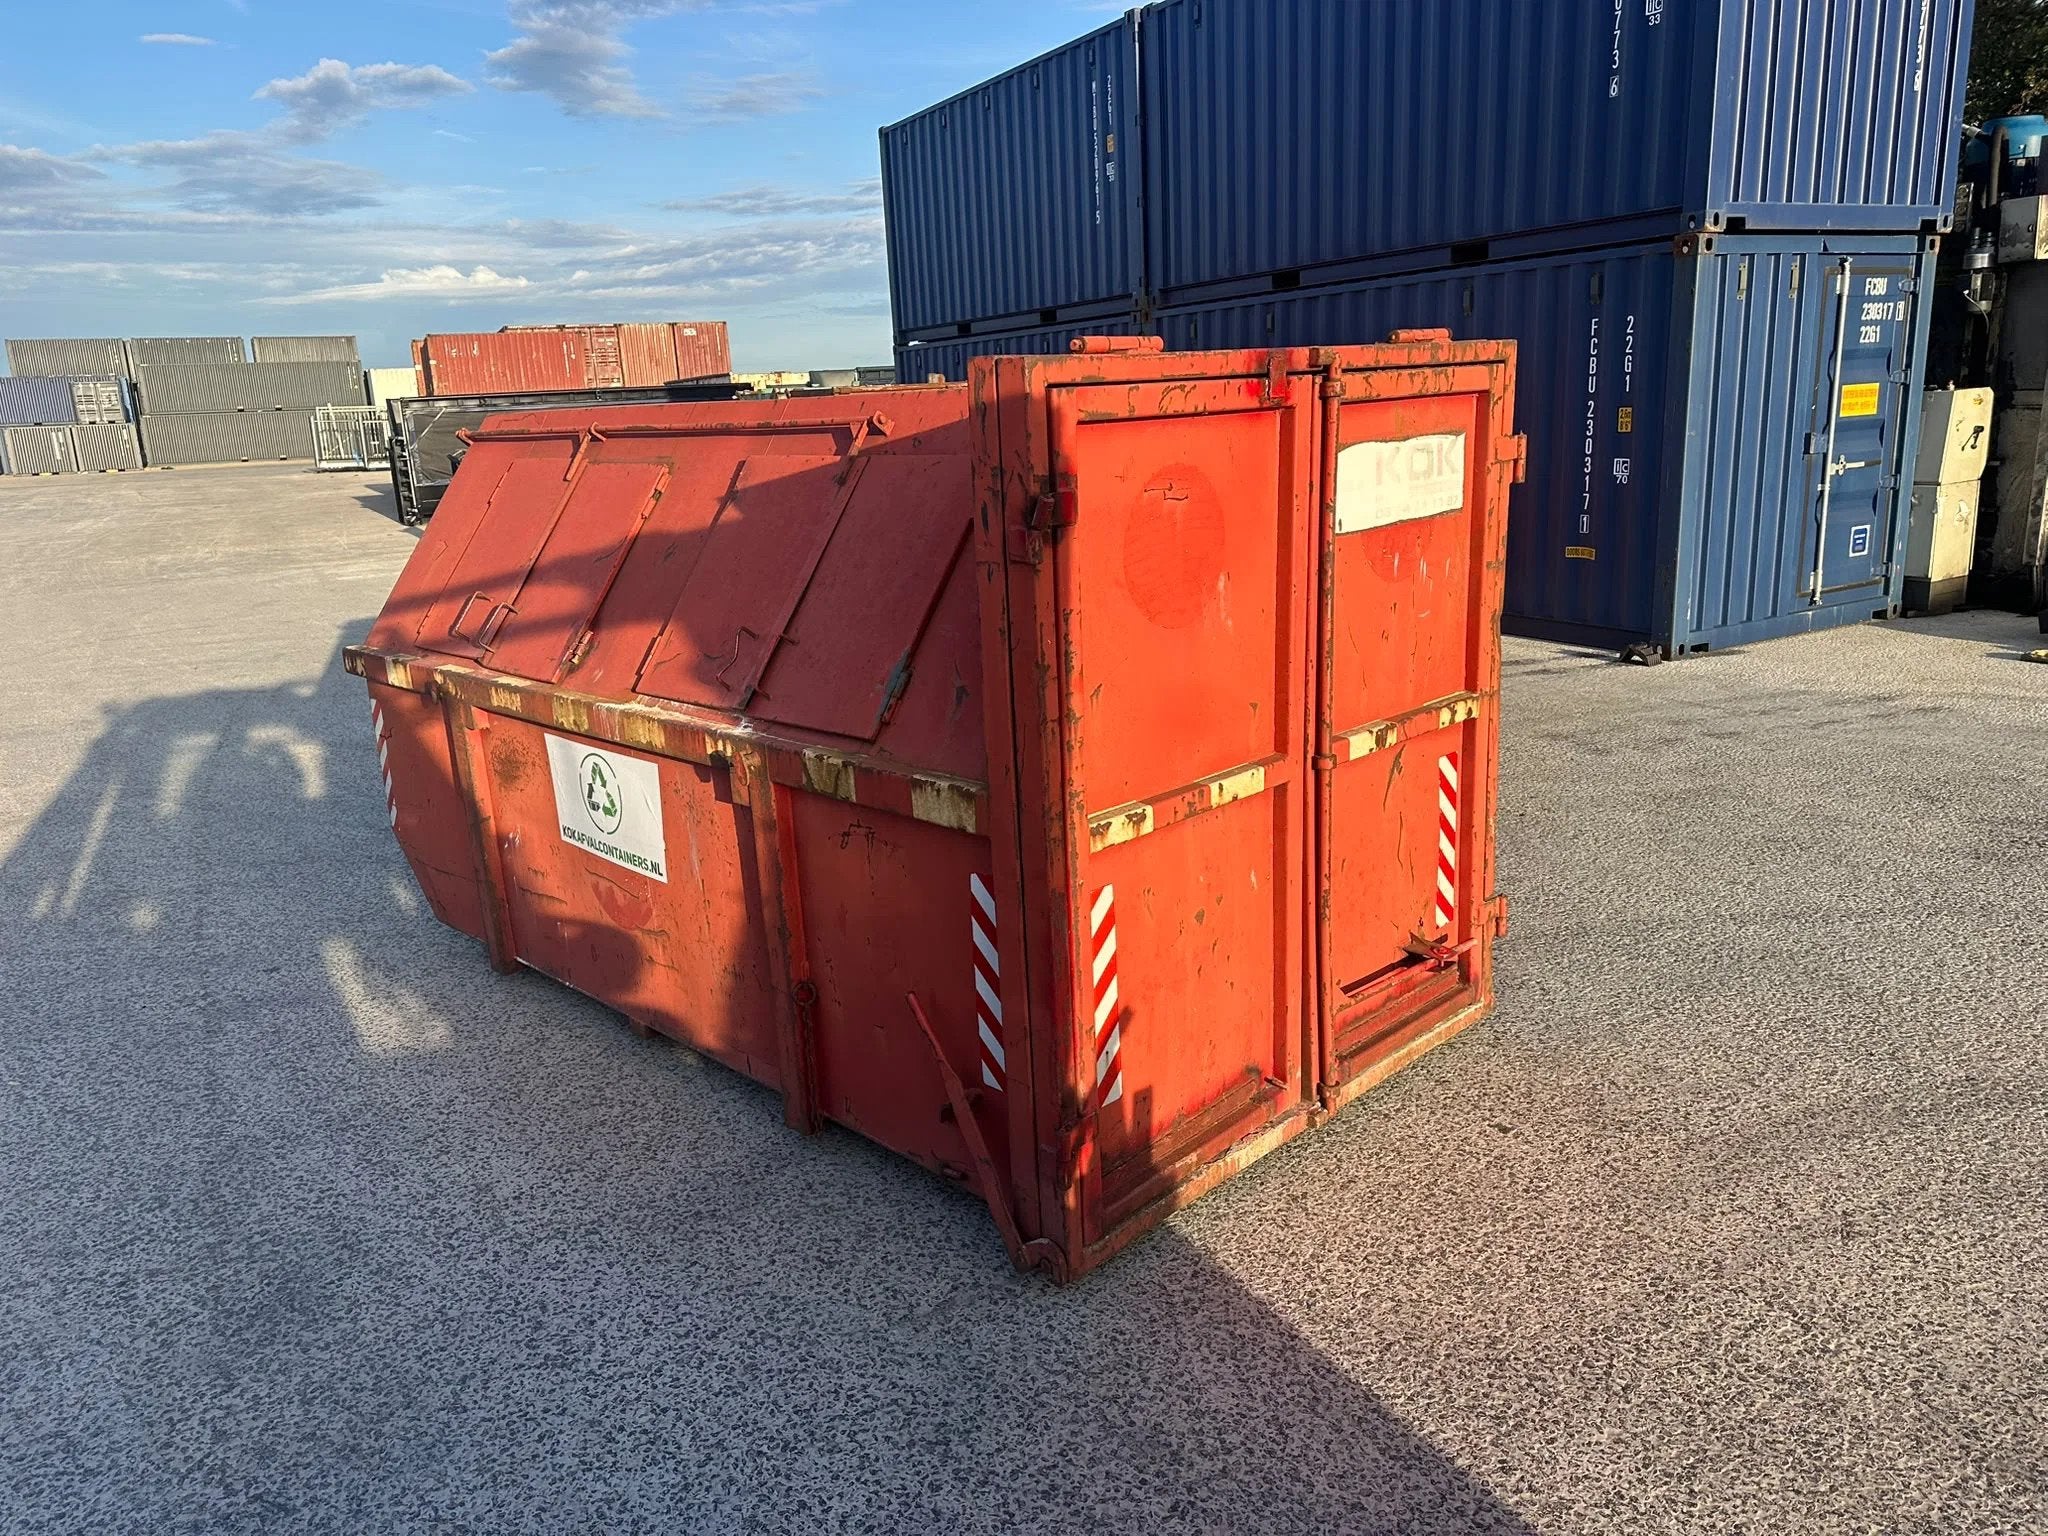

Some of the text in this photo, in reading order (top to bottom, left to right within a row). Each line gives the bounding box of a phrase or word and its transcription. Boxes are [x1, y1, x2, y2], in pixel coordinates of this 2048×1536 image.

[1649, 14, 1660, 25] 33
[1610, 76, 1618, 97] 6
[1865, 277, 1888, 296] FCBU
[1861, 302, 1894, 320] 230317
[1625, 315, 1634, 392] 22G1
[1581, 318, 1599, 533] FCBU 230317 1
[1376, 439, 1459, 487] KOK
[1616, 475, 1628, 484] 70
[562, 824, 663, 877] KOKAFVALCONTAINERS.NL
